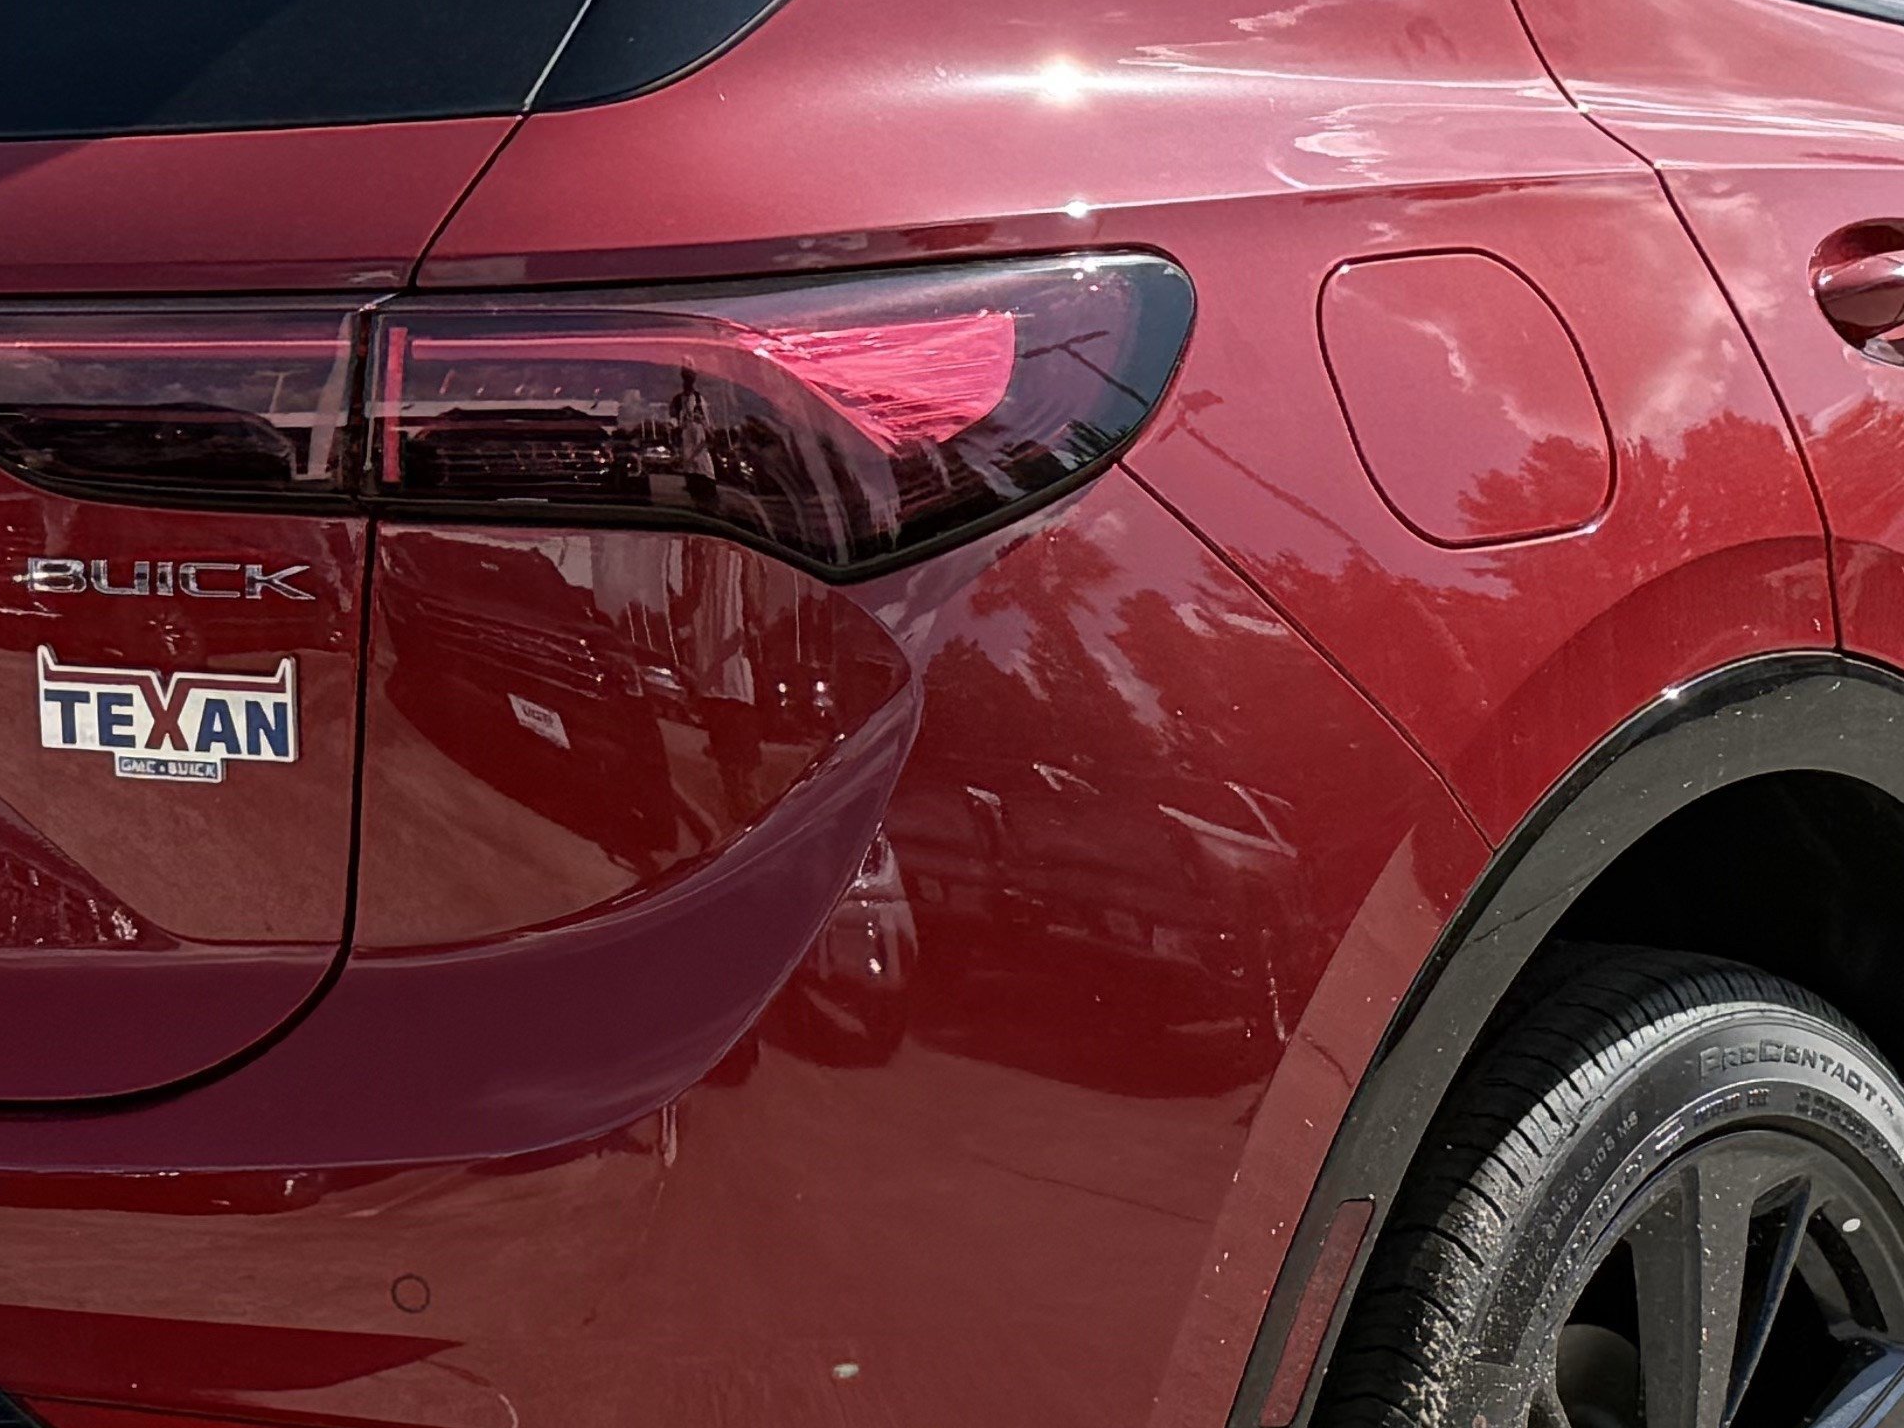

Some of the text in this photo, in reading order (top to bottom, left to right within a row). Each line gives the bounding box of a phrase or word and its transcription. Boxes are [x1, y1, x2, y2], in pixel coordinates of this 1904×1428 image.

[27, 557, 317, 600] BUICK
[43, 678, 291, 757] TEXAN
[120, 758, 216, 778] GMC BUICK
